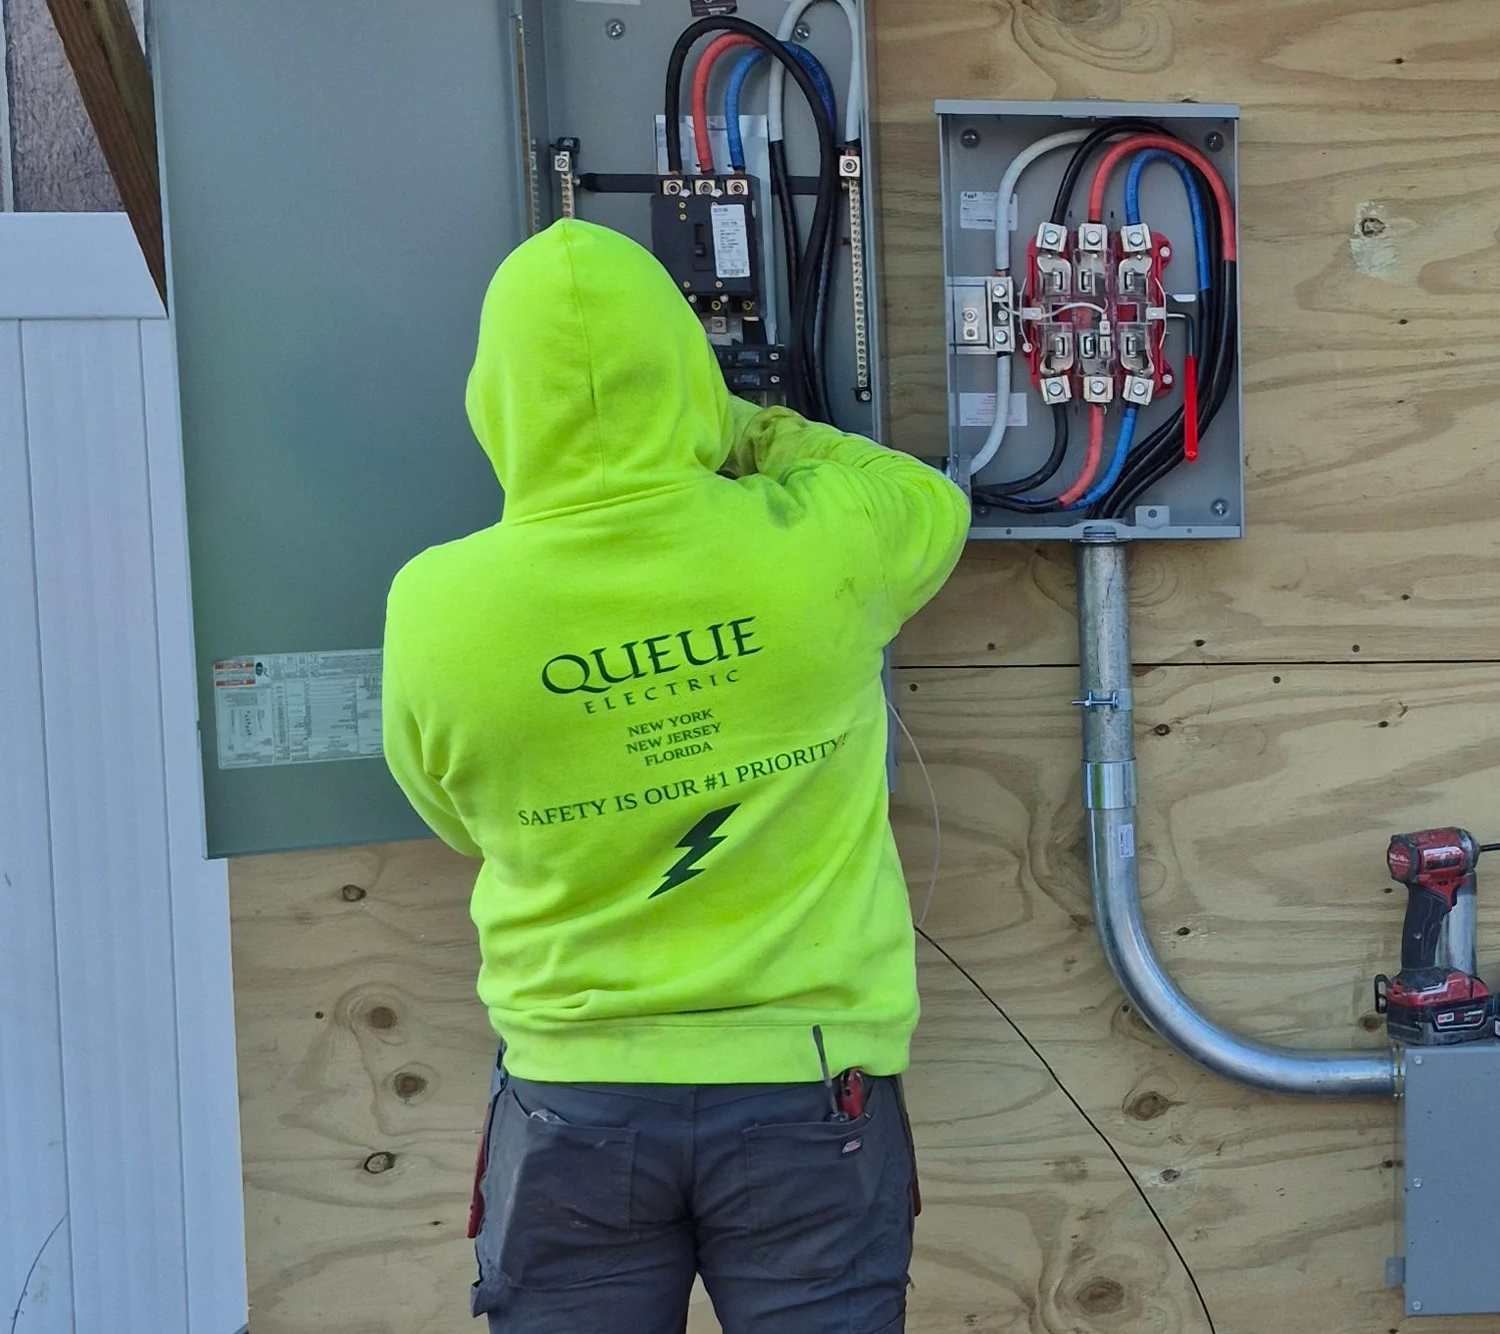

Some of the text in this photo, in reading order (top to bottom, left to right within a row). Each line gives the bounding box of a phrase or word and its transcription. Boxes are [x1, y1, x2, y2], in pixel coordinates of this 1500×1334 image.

[541, 616, 765, 695] QUEUE
[583, 669, 741, 715] ELECTRIC
[626, 722, 723, 754] NEW JERSEY
[627, 708, 714, 737] NEW YORK
[643, 741, 713, 767] FLORIDA
[517, 798, 607, 827] SAFETY
[615, 793, 638, 812] IS
[643, 778, 700, 805] OUR
[704, 771, 730, 792] #1
